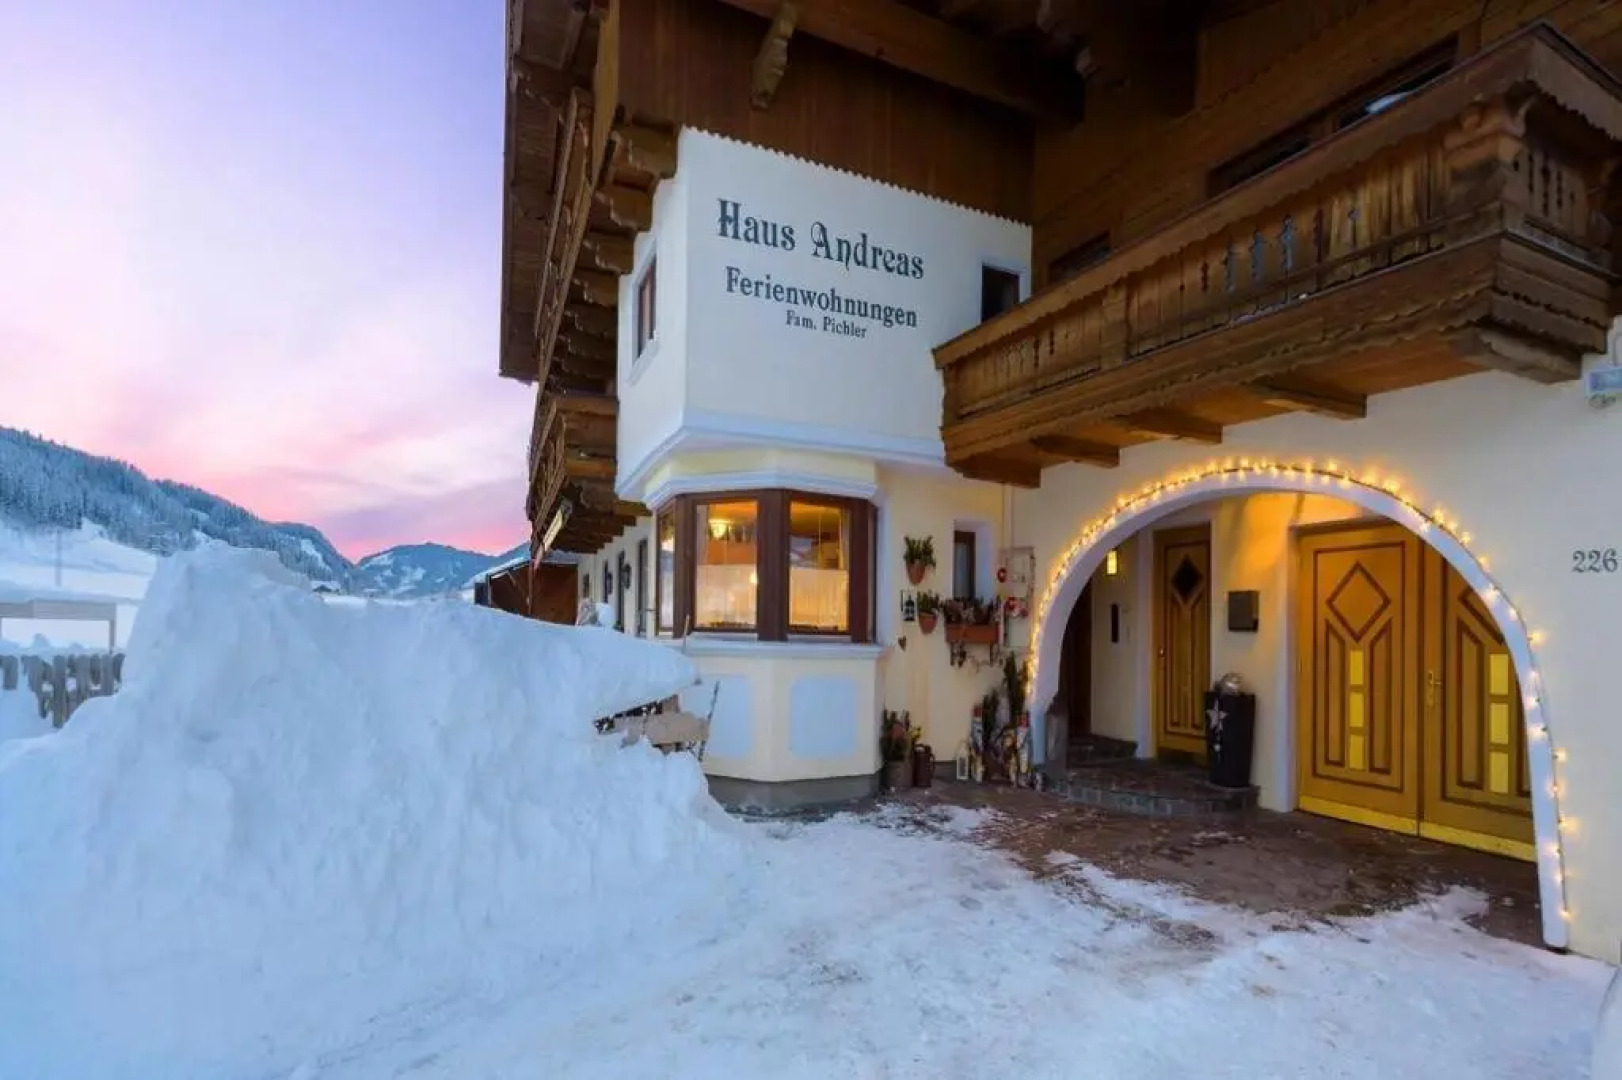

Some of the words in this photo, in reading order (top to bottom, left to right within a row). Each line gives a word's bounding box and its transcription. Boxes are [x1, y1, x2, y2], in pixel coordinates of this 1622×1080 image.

[717, 197, 796, 251] Haus
[810, 221, 925, 279] Andreas
[725, 265, 917, 328] Ferienwohnungen
[785, 309, 817, 330] Fam.
[822, 315, 868, 339] Pichler
[1571, 548, 1619, 574] 226
